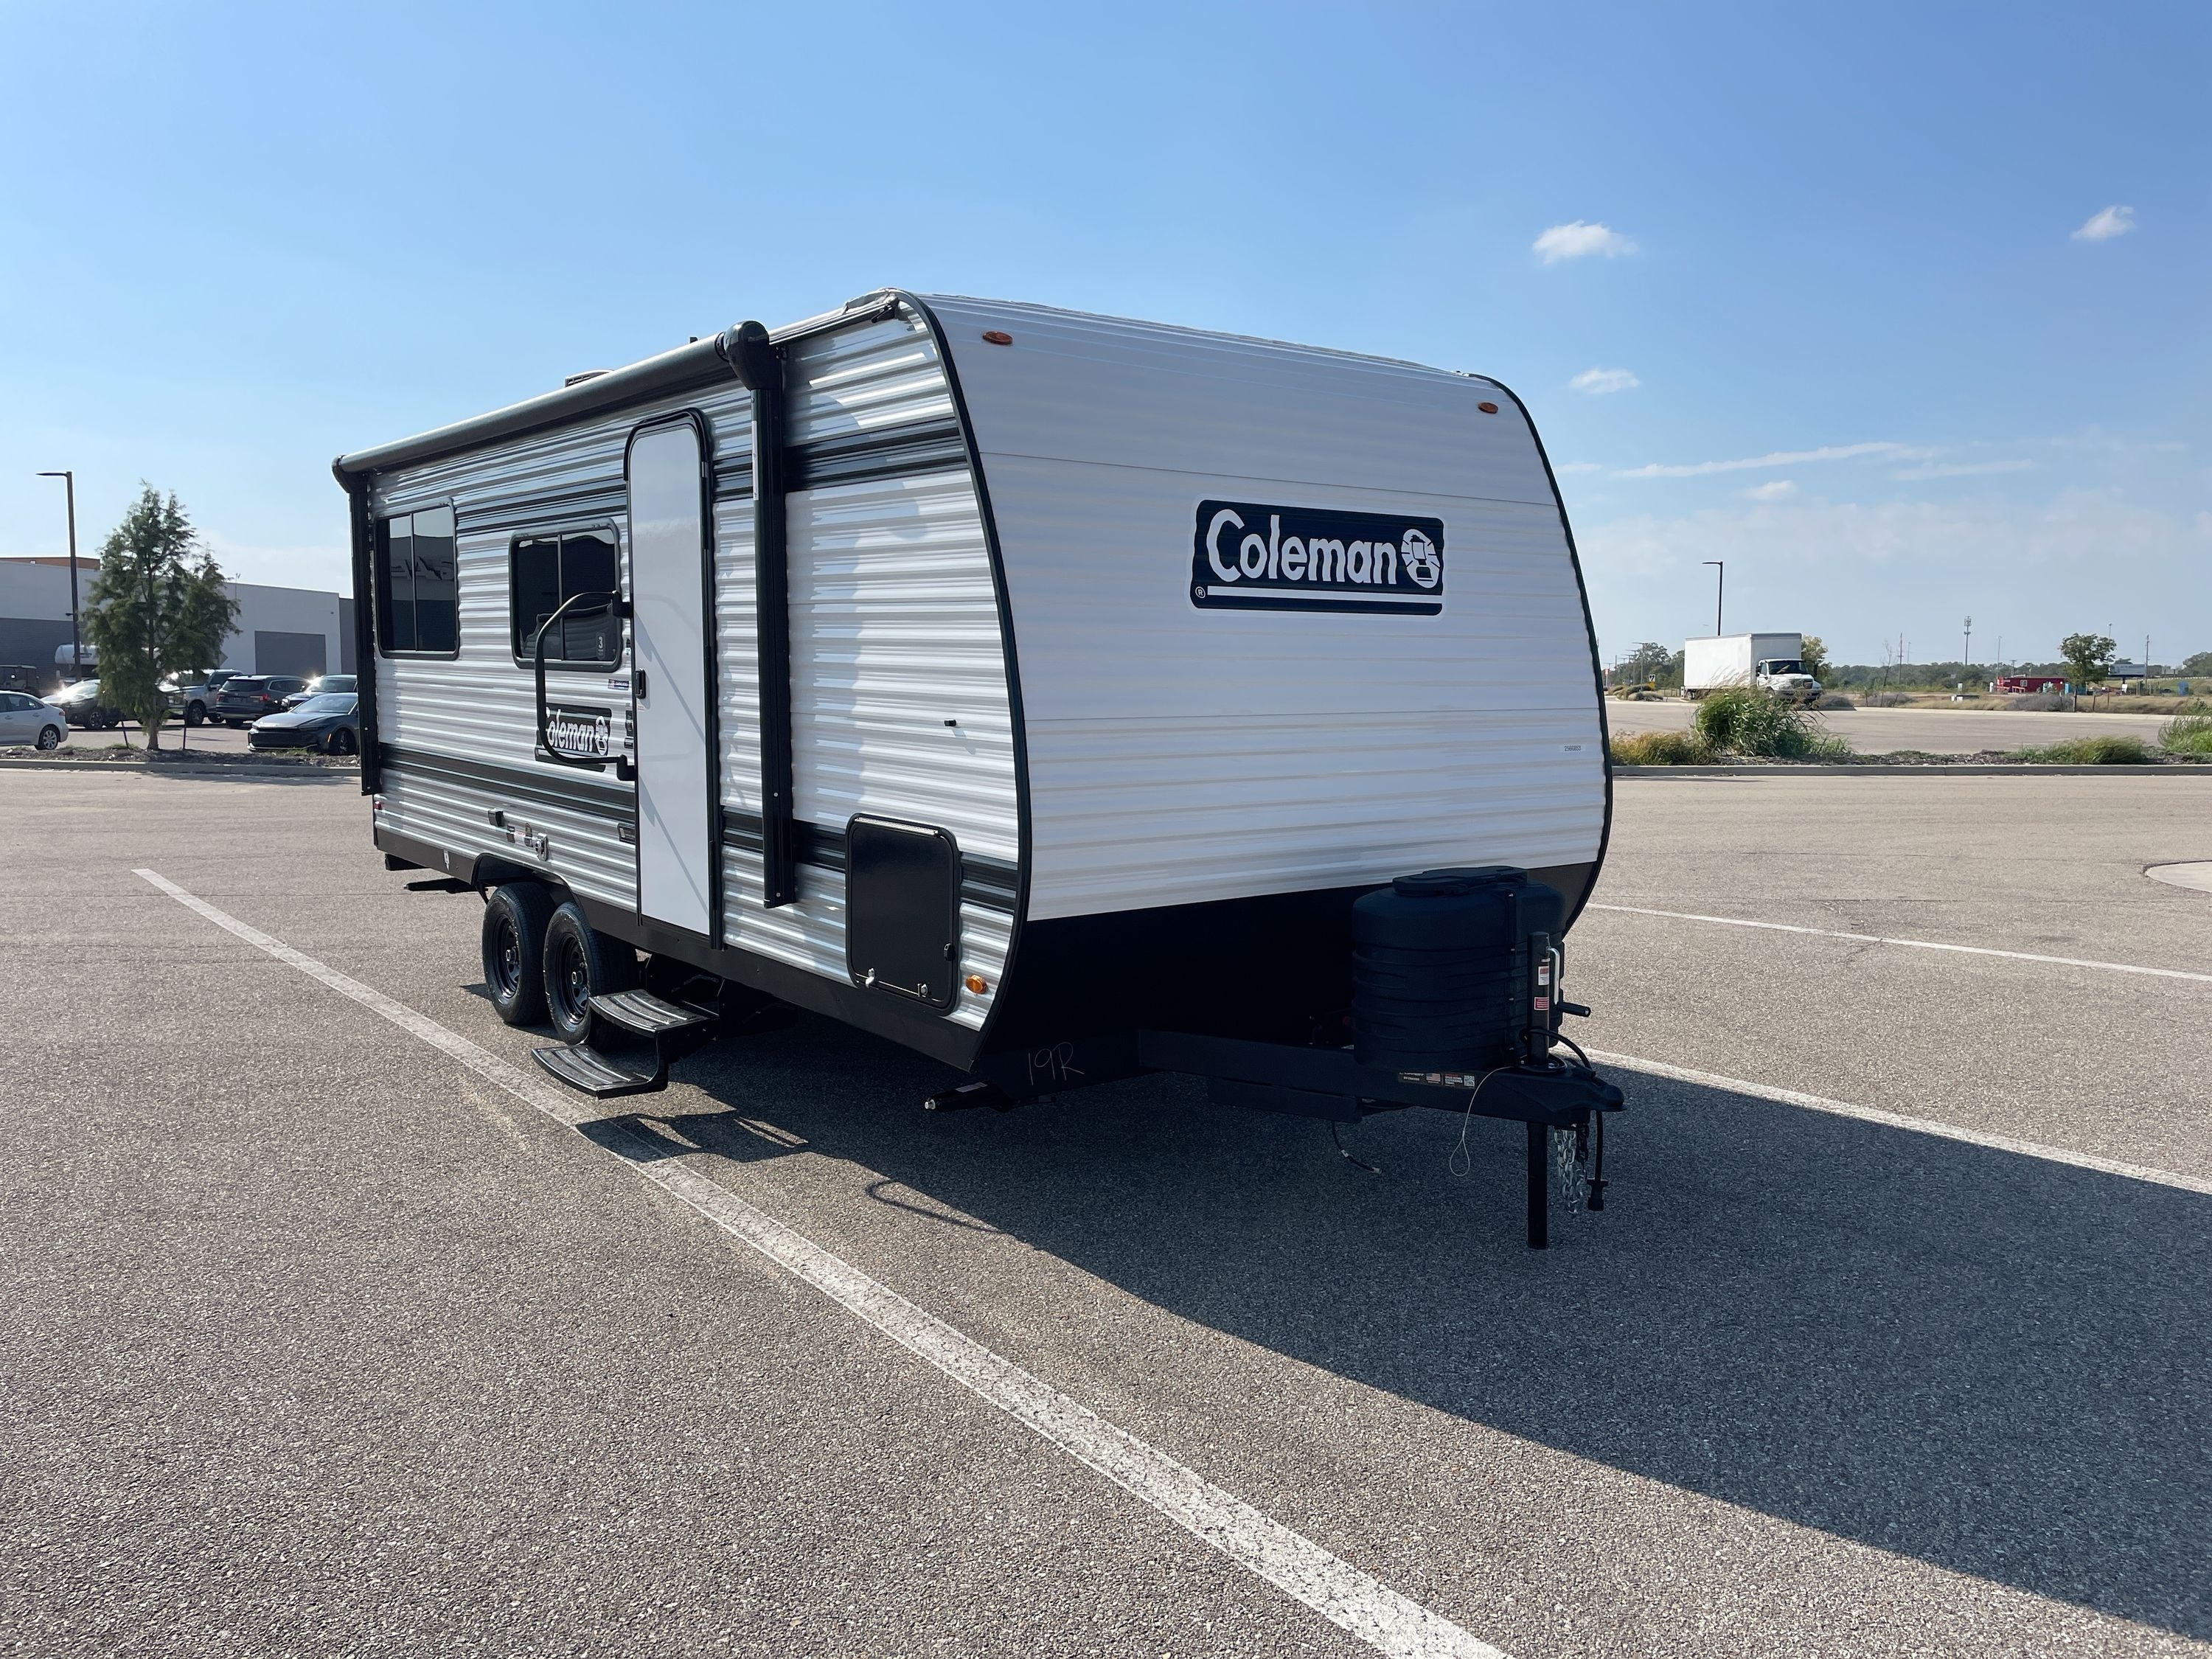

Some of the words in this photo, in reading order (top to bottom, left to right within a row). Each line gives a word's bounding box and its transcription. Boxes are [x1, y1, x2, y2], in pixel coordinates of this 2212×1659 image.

[1206, 509, 1397, 585] Coleman
[543, 706, 594, 752] oleman
[1028, 1042, 1085, 1086] 19R
